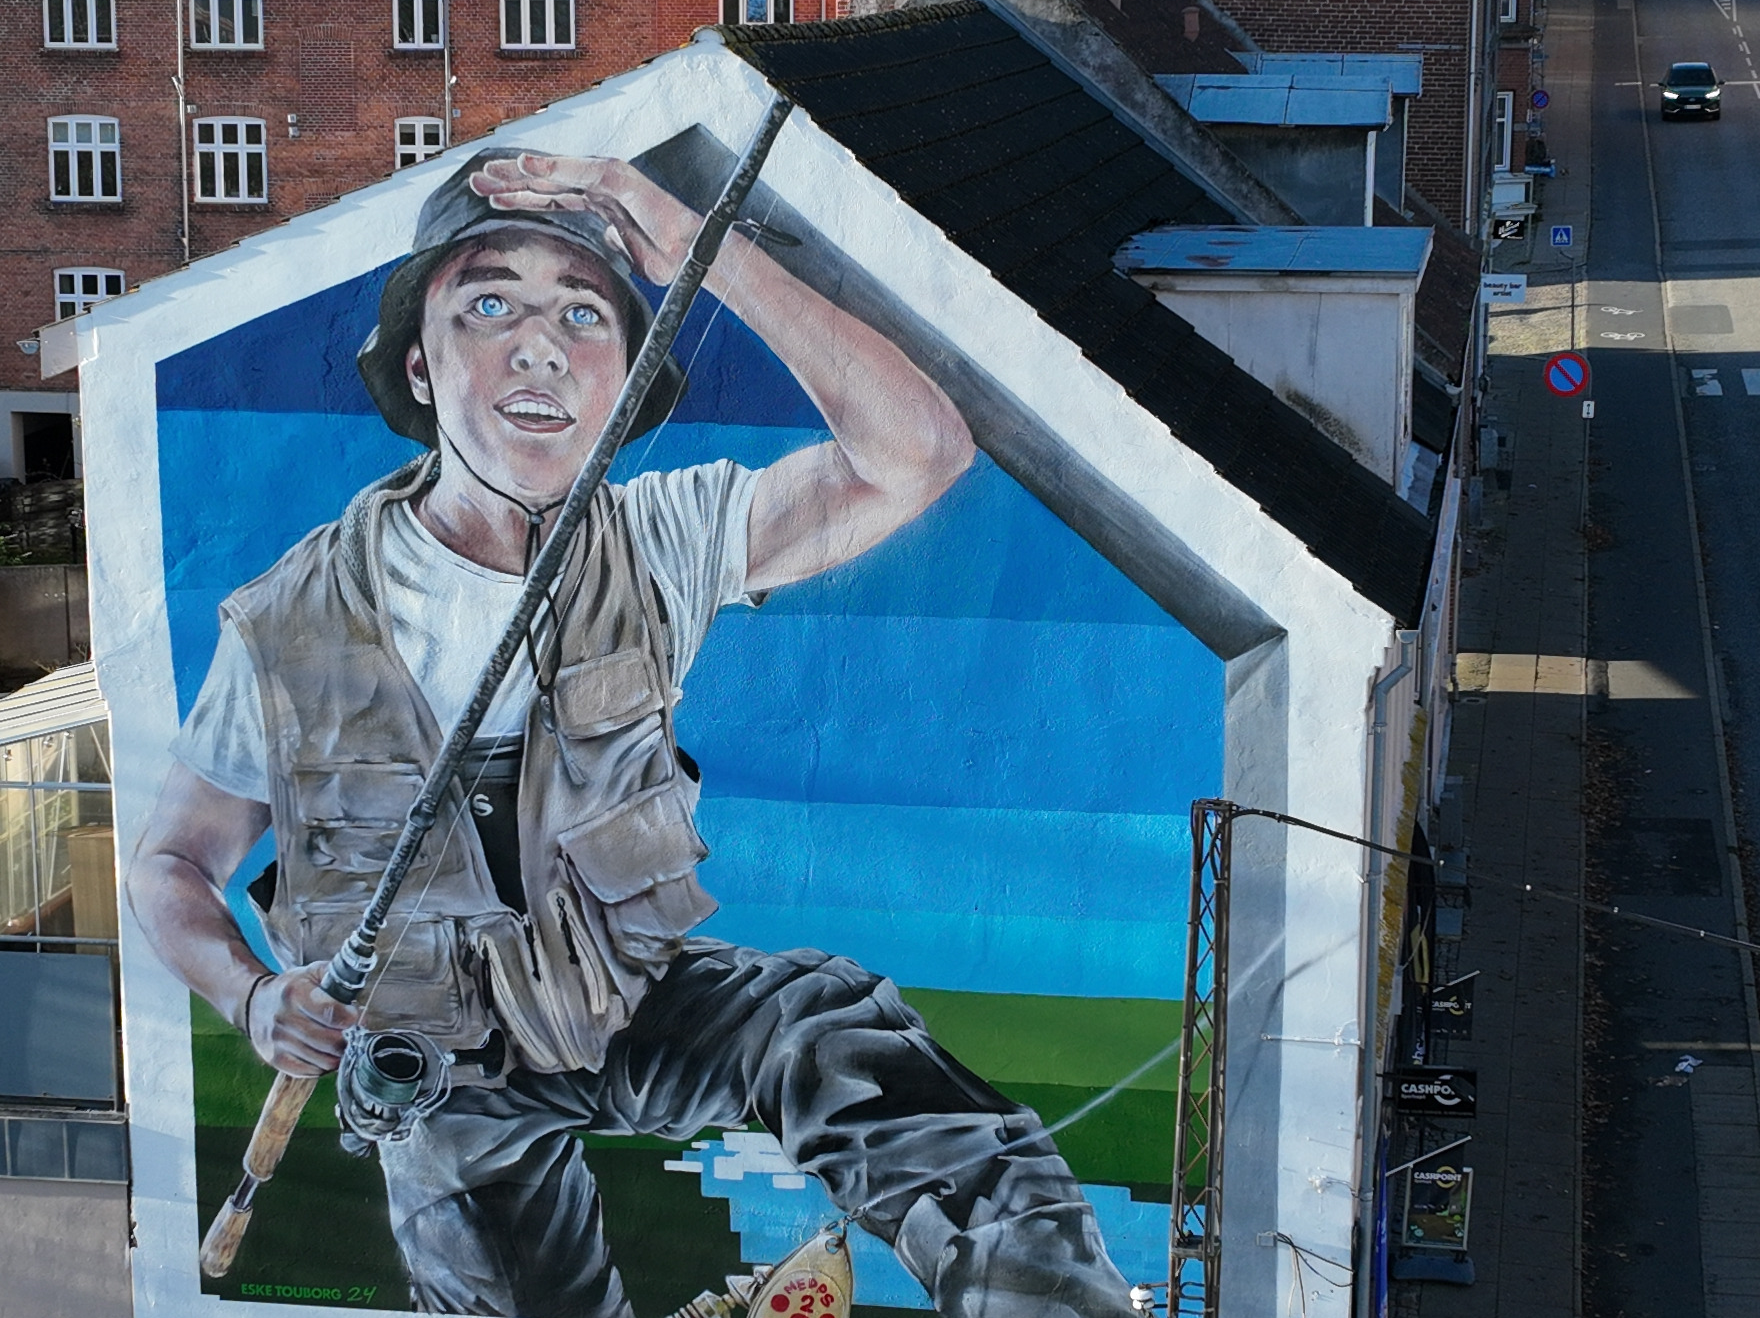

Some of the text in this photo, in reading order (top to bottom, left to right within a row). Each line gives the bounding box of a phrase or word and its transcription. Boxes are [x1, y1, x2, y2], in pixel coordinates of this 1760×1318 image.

[1483, 282, 1507, 292] beauty
[1413, 1170, 1463, 1182] CASHPOINT
[241, 1283, 378, 1304] ESKE TOUBORG 24
[800, 1294, 815, 1314] 2
